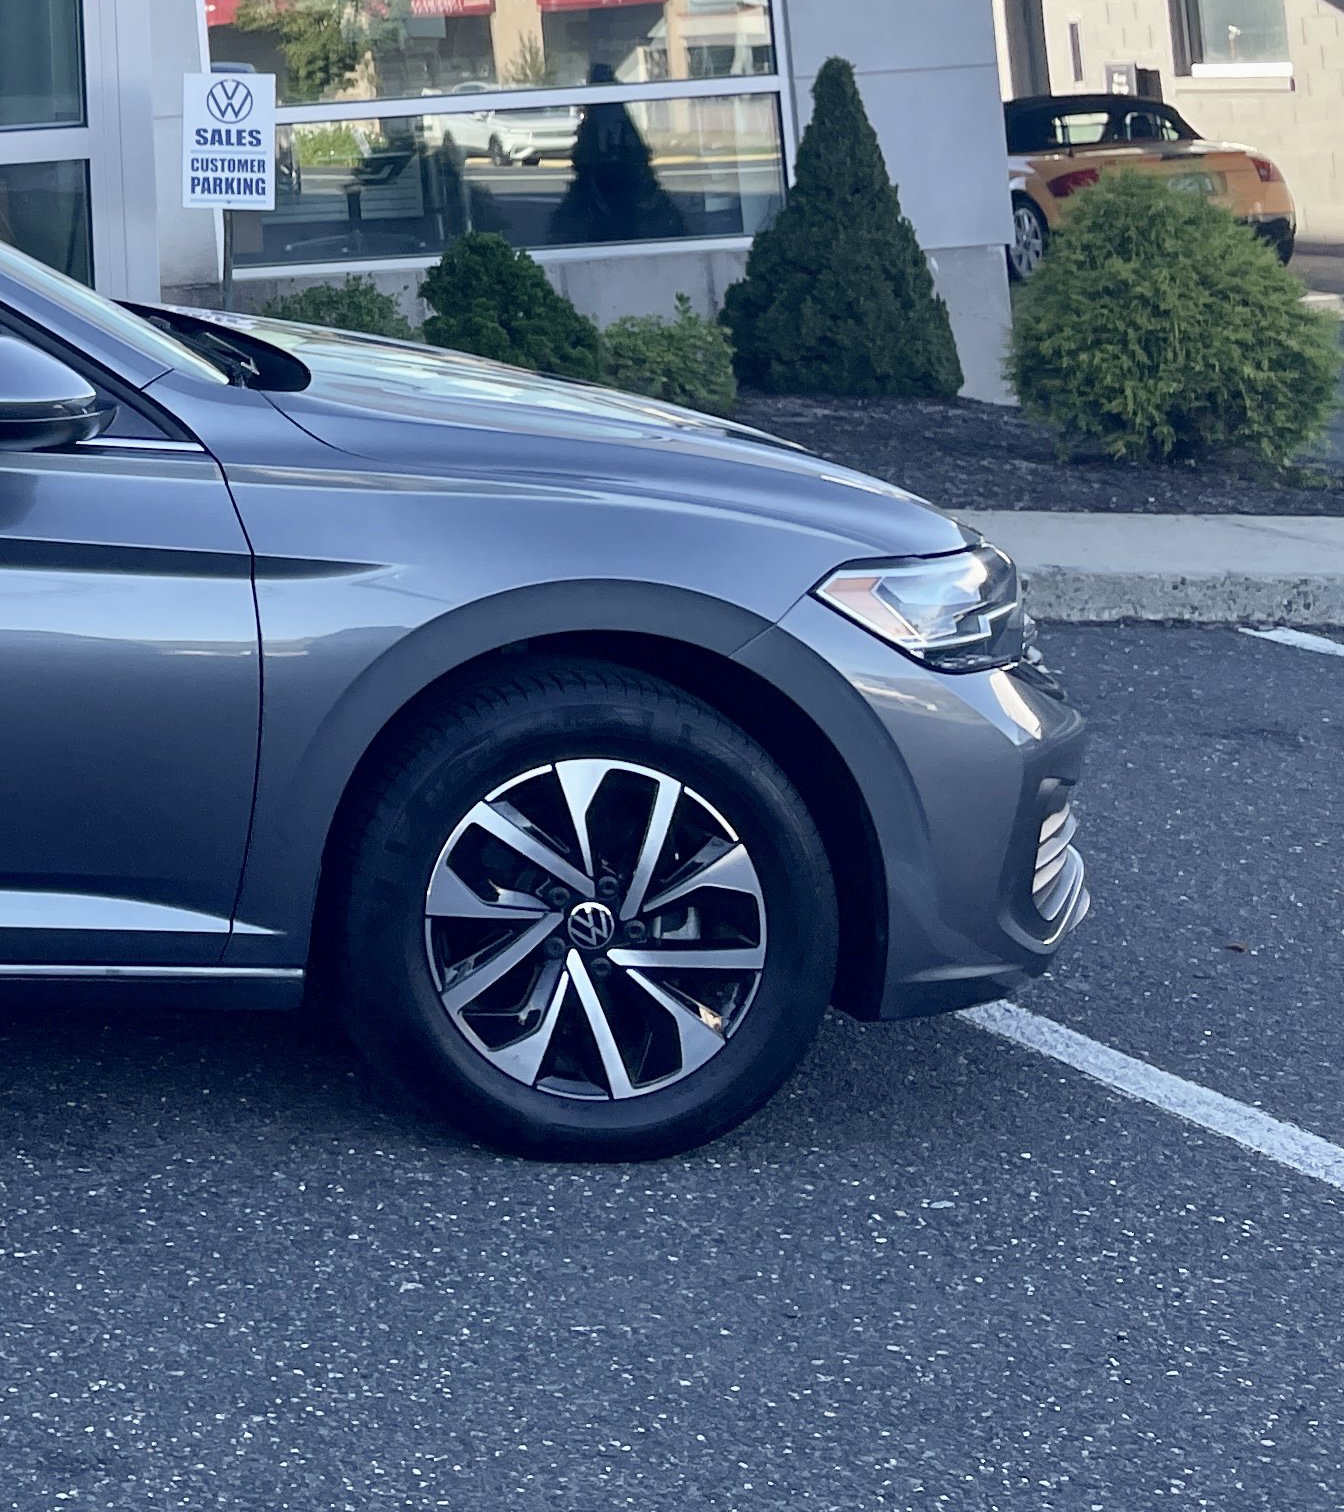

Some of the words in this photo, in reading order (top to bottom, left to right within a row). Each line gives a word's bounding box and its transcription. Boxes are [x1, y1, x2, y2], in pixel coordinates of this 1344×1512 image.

[195, 128, 262, 147] SALES
[191, 158, 266, 173] CUSTOMER
[190, 176, 266, 196] PARKING
